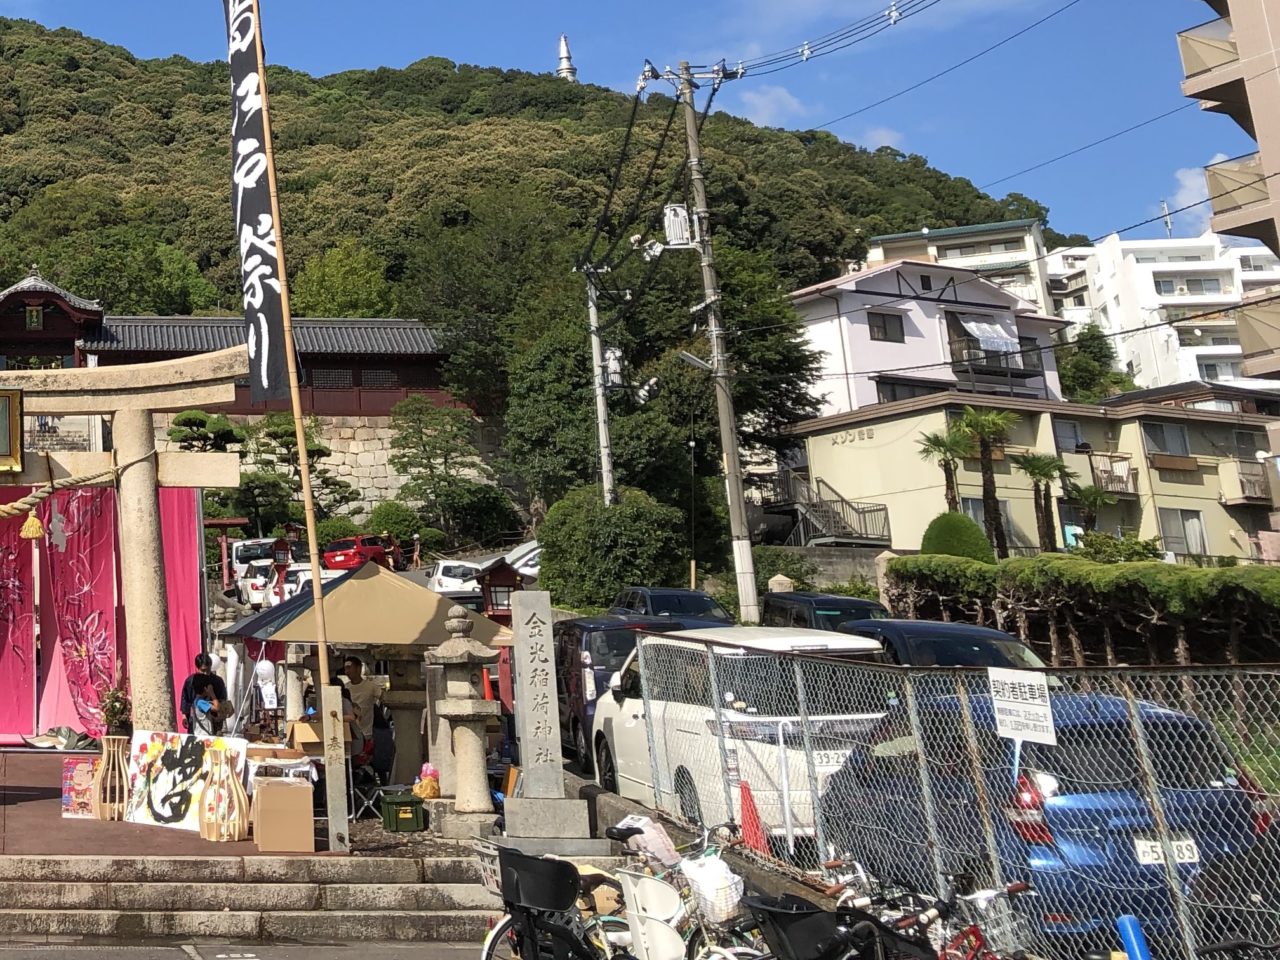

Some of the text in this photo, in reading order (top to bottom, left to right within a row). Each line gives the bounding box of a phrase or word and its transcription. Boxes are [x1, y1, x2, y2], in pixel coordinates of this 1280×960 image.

[524, 612, 555, 764] 金光稲荷神社
[991, 679, 1048, 704] 契約者駐車場
